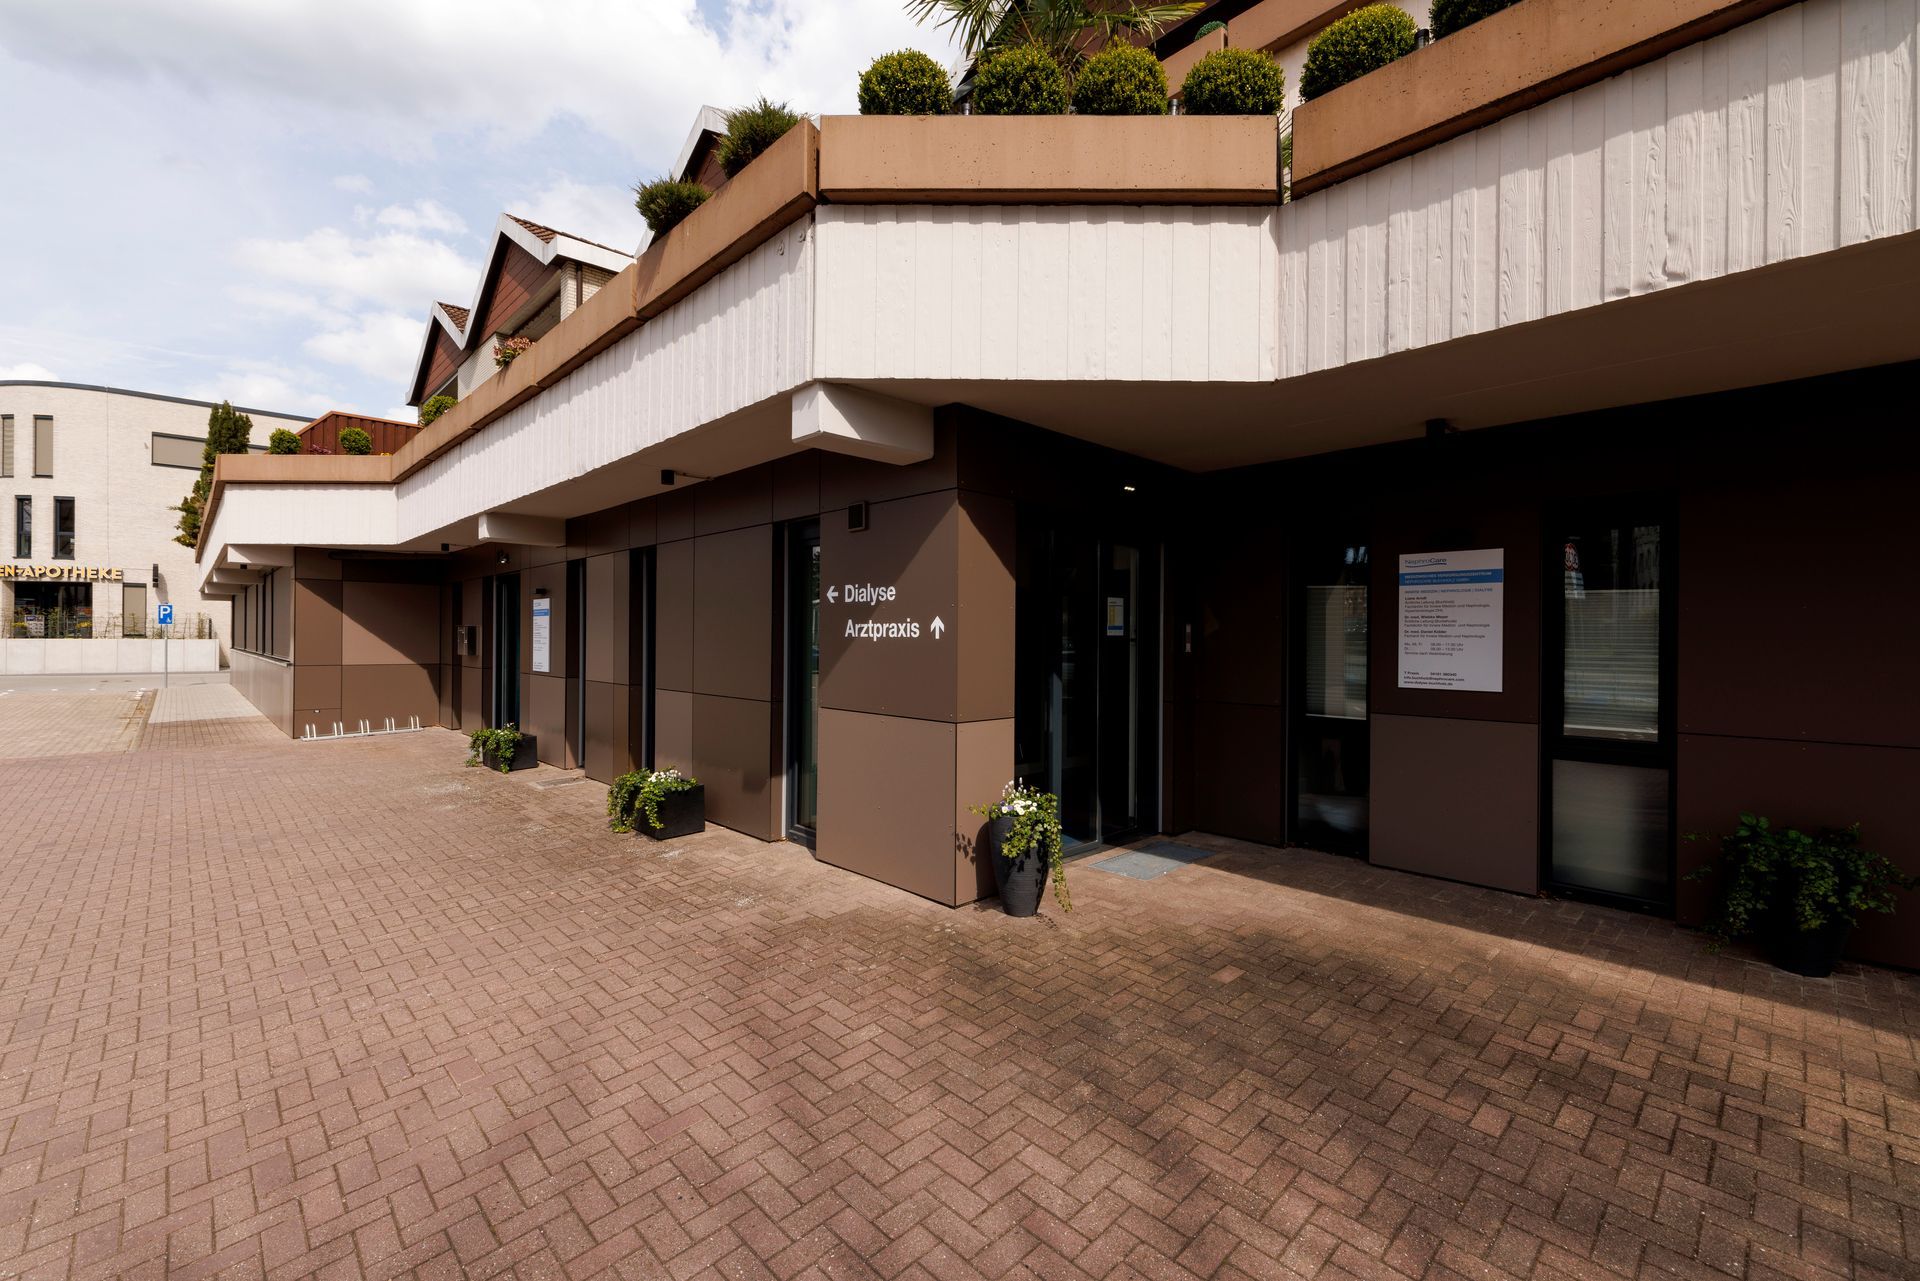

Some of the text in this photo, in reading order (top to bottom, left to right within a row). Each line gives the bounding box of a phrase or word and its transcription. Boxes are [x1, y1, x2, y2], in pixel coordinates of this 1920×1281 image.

[1404, 557, 1447, 566] NephroCare
[844, 583, 896, 606] Dialyse
[160, 606, 170, 619] P
[844, 618, 920, 642] Arztpraxis
